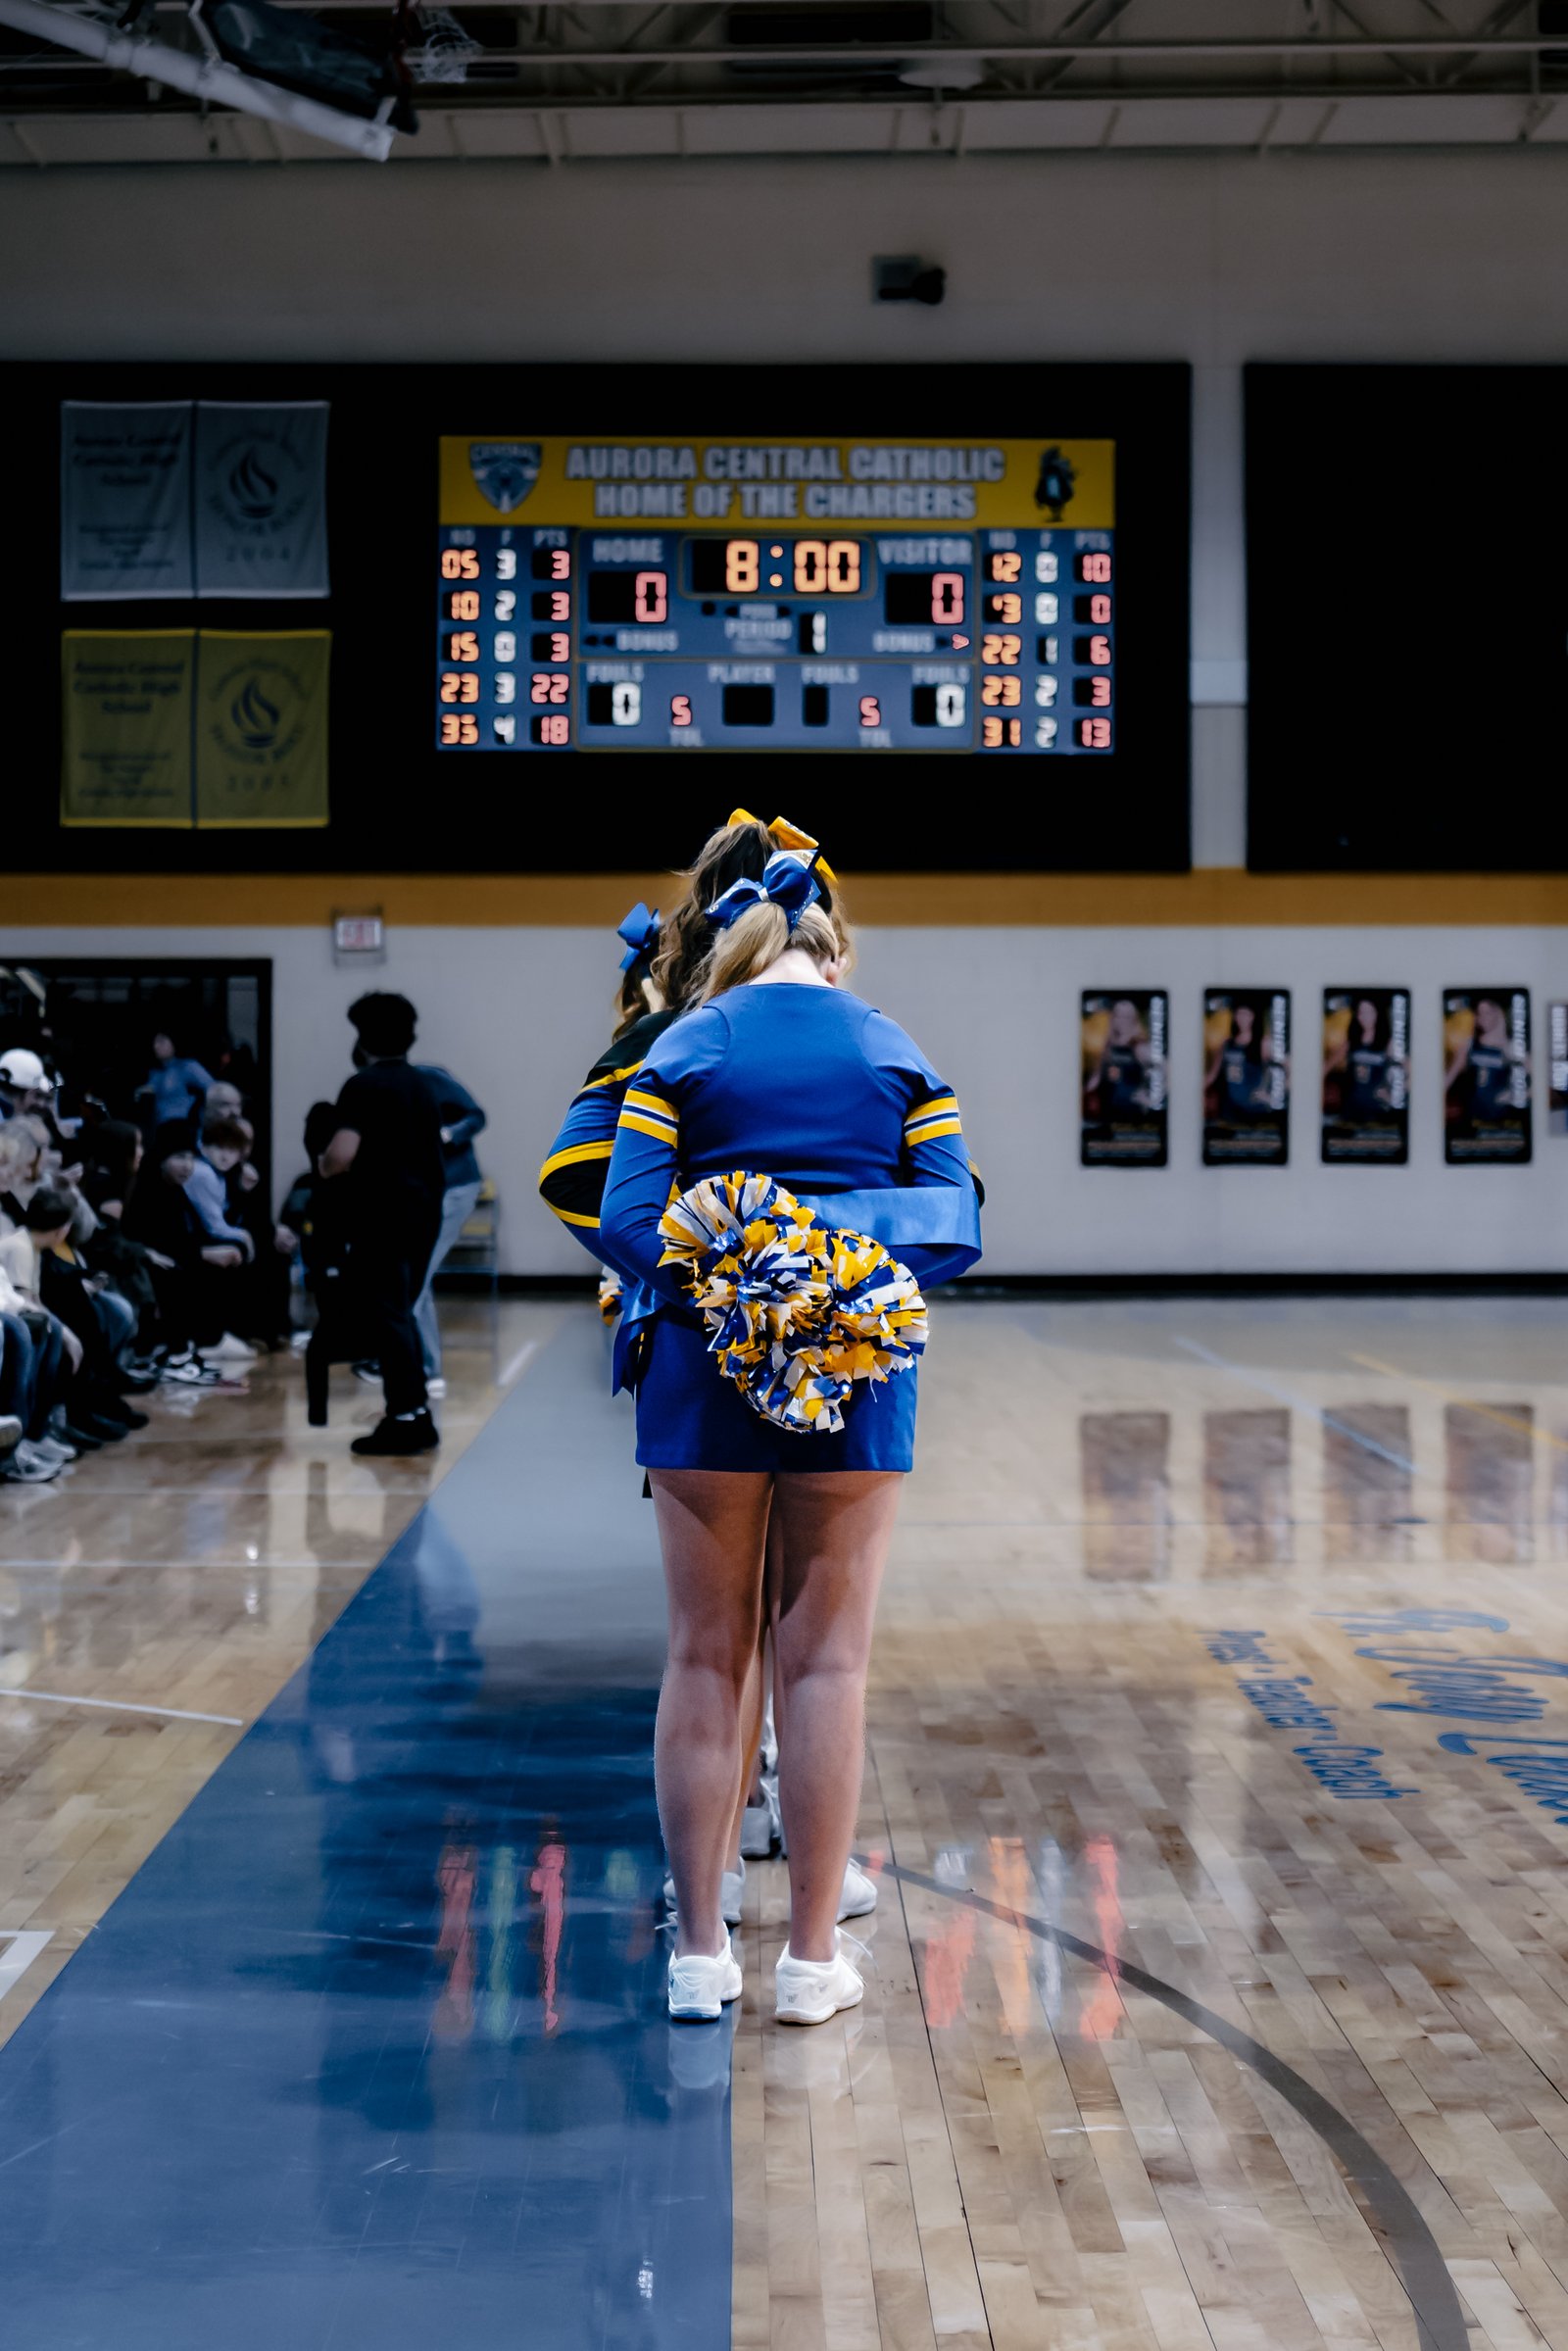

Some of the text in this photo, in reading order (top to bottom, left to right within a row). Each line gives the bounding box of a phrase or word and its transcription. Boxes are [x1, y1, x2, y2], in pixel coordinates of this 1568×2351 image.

[565, 446, 1005, 481] AURORA CENTRAL CATHOLIC
[594, 484, 976, 519] HOME OF THE CHARGERS
[533, 530, 567, 547] PTS
[593, 539, 664, 563] HOME
[878, 539, 972, 564] VISITOR
[496, 548, 517, 579] 3
[551, 550, 570, 579] 3
[726, 540, 860, 592] 8:00
[494, 590, 516, 621] 2
[551, 590, 570, 621] 3
[635, 571, 667, 622] 0
[932, 572, 964, 624] 0
[1091, 594, 1111, 624] 0
[451, 631, 479, 662] 15
[551, 632, 570, 662] 3
[982, 634, 1022, 665] 22
[1090, 635, 1111, 665] 6
[440, 671, 570, 704] 23 3 22
[612, 682, 641, 726] 0
[982, 674, 1111, 707] 23 2 3
[936, 684, 966, 727] 0
[440, 713, 570, 746] 35 4 18
[982, 715, 1022, 748] 31
[1035, 715, 1057, 749] 2
[1235, 1675, 1340, 1732] Teacher
[1292, 1745, 1420, 1800] Coach
